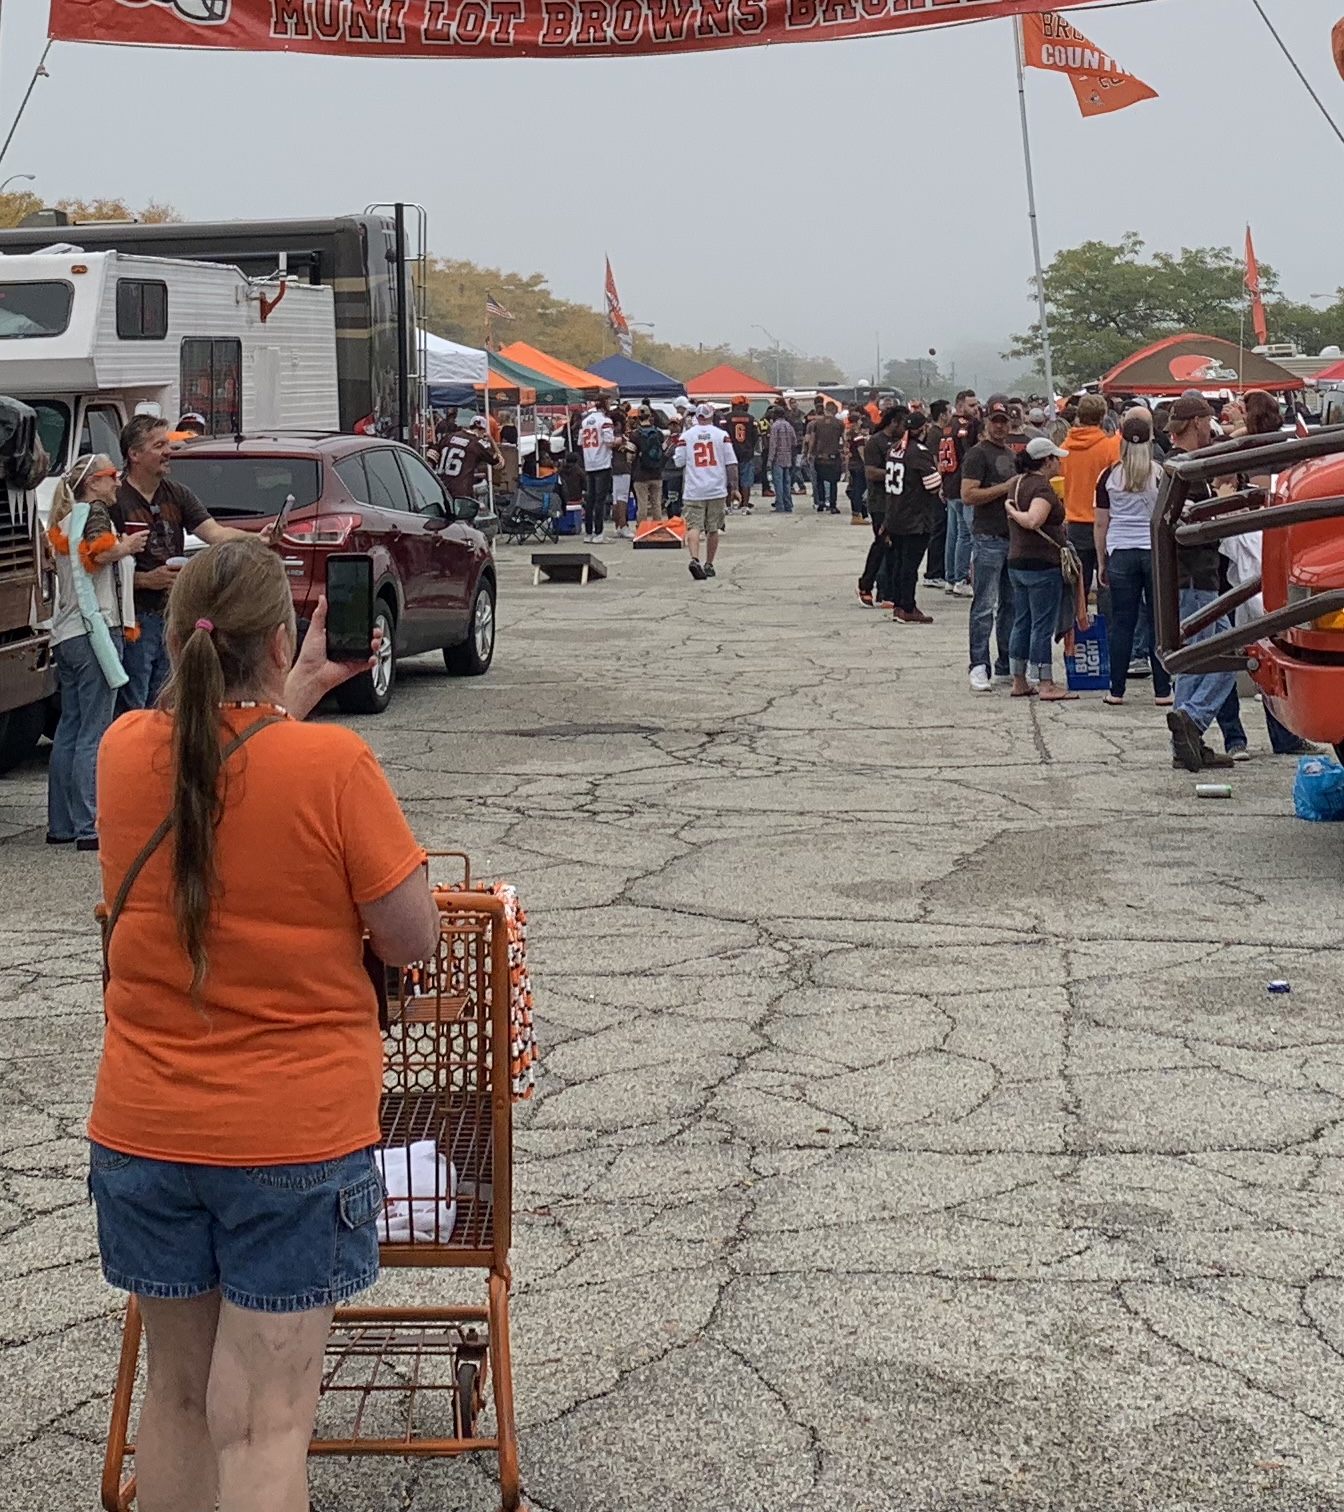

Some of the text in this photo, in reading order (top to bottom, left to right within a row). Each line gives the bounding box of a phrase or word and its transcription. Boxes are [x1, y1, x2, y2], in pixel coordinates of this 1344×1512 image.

[438, 447, 466, 477] 16
[693, 442, 718, 467] 21
[885, 461, 905, 496] 23
[1074, 642, 1087, 674] BUD
[1086, 639, 1100, 677] LIGHT
